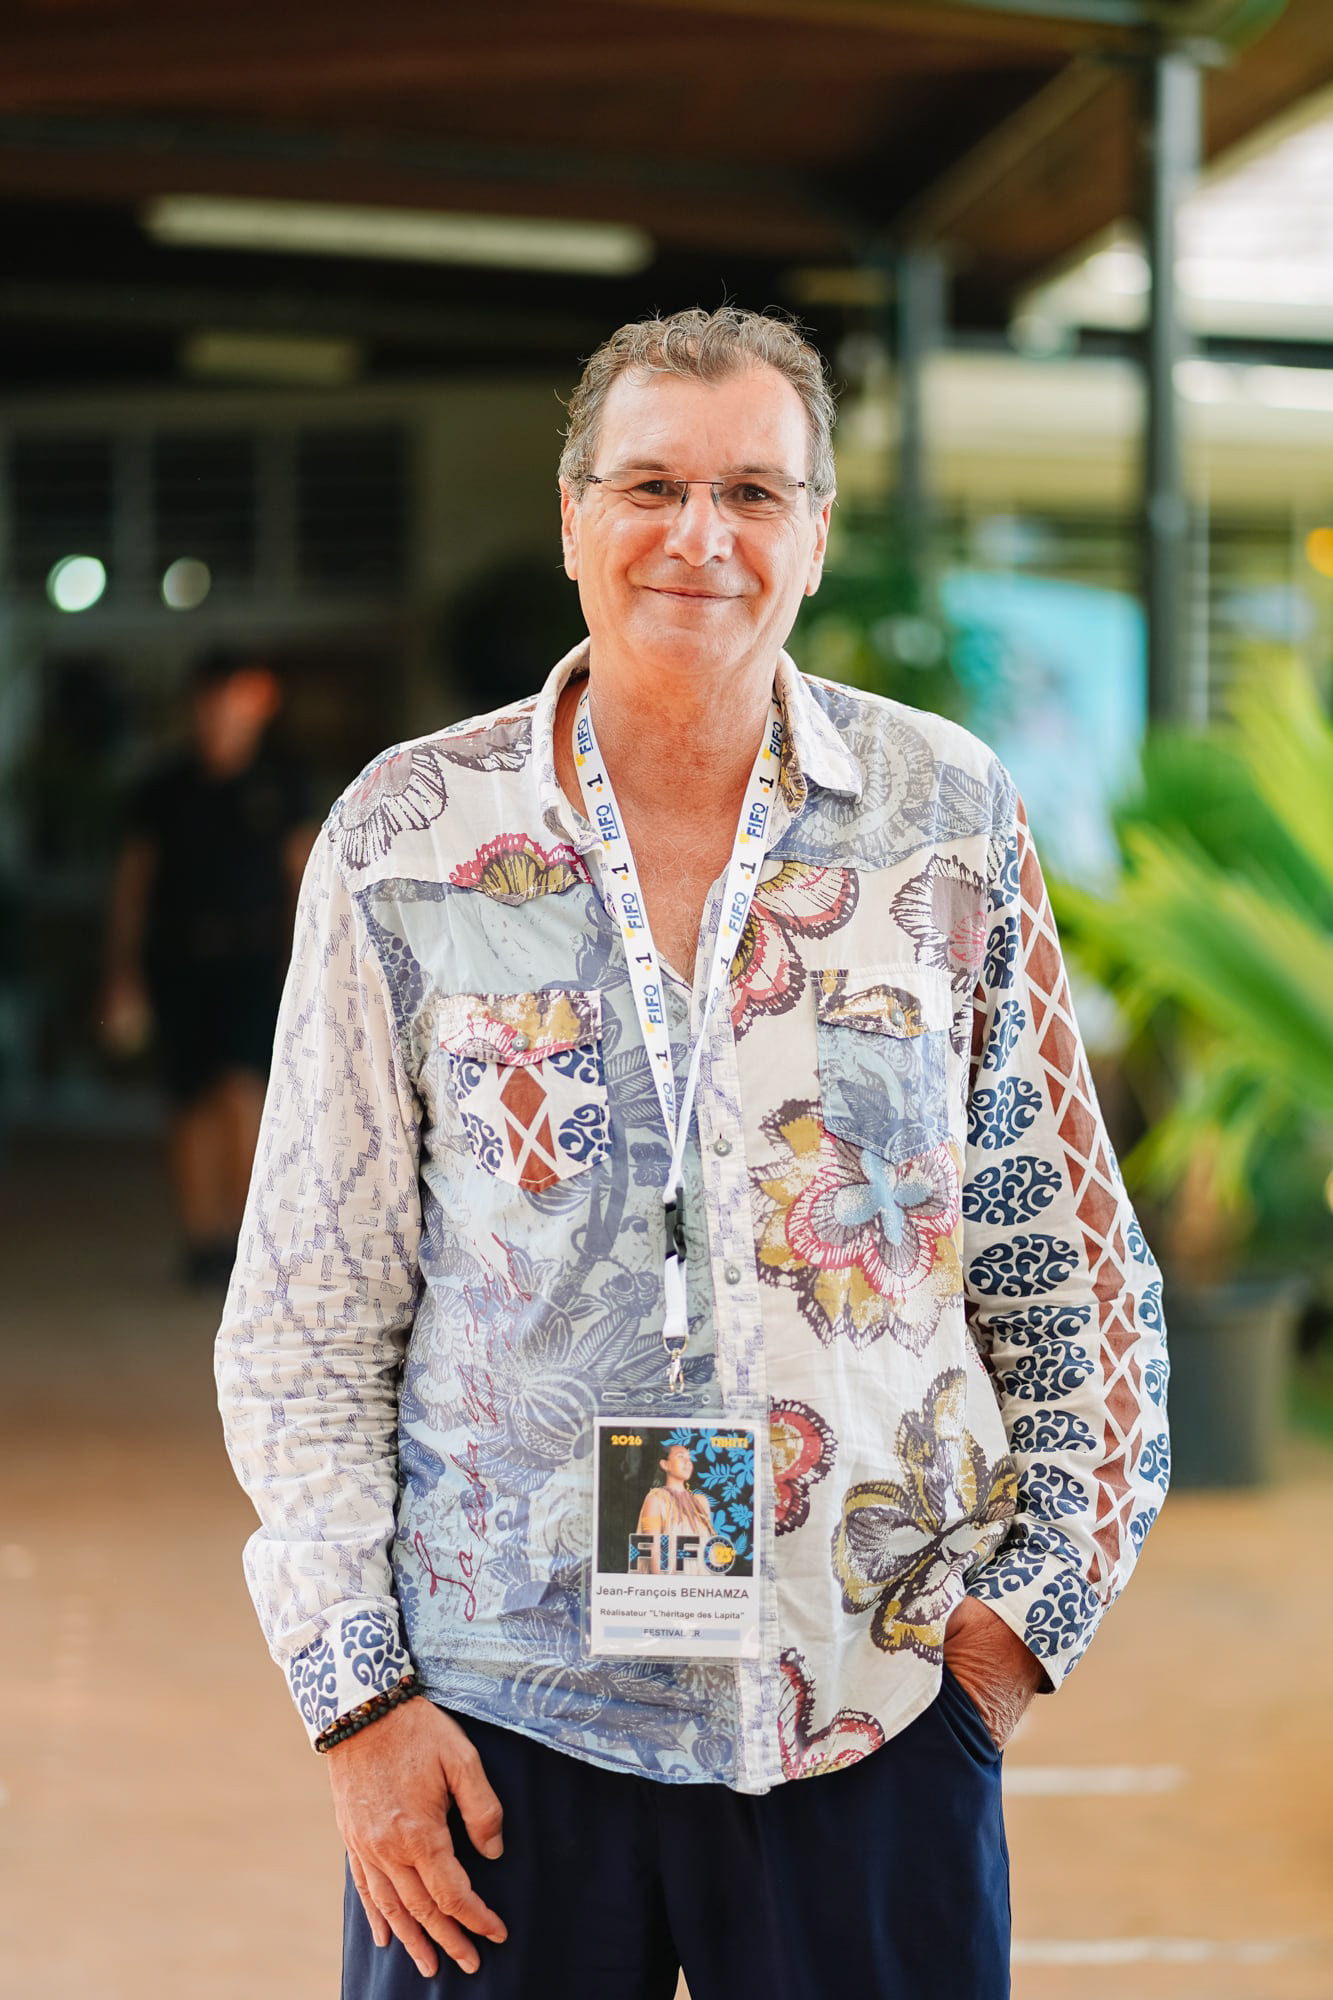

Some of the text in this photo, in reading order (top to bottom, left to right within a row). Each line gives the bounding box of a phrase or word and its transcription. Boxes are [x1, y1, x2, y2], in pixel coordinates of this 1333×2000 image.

[577, 717, 593, 755] FIFO
[769, 721, 783, 758] FIFO
[587, 773, 604, 788] 1
[759, 776, 775, 789] 1
[596, 804, 619, 841] FIFO
[746, 802, 767, 838] FIFO
[611, 862, 629, 874] 1
[740, 861, 757, 874] 1
[621, 892, 643, 929] FIFO
[728, 891, 747, 933] FIFO
[635, 952, 653, 964] 1
[643, 984, 663, 1024] FIFO
[655, 1049, 669, 1062] 1
[611, 1434, 643, 1446] 2026
[628, 1533, 736, 1575] FIFO
[596, 1585, 750, 1599] Jean-François BENHAMZA
[600, 1608, 647, 1617] Réalisateur
[697, 1611, 712, 1619] des
[643, 1628, 701, 1637] FESTIVALR
